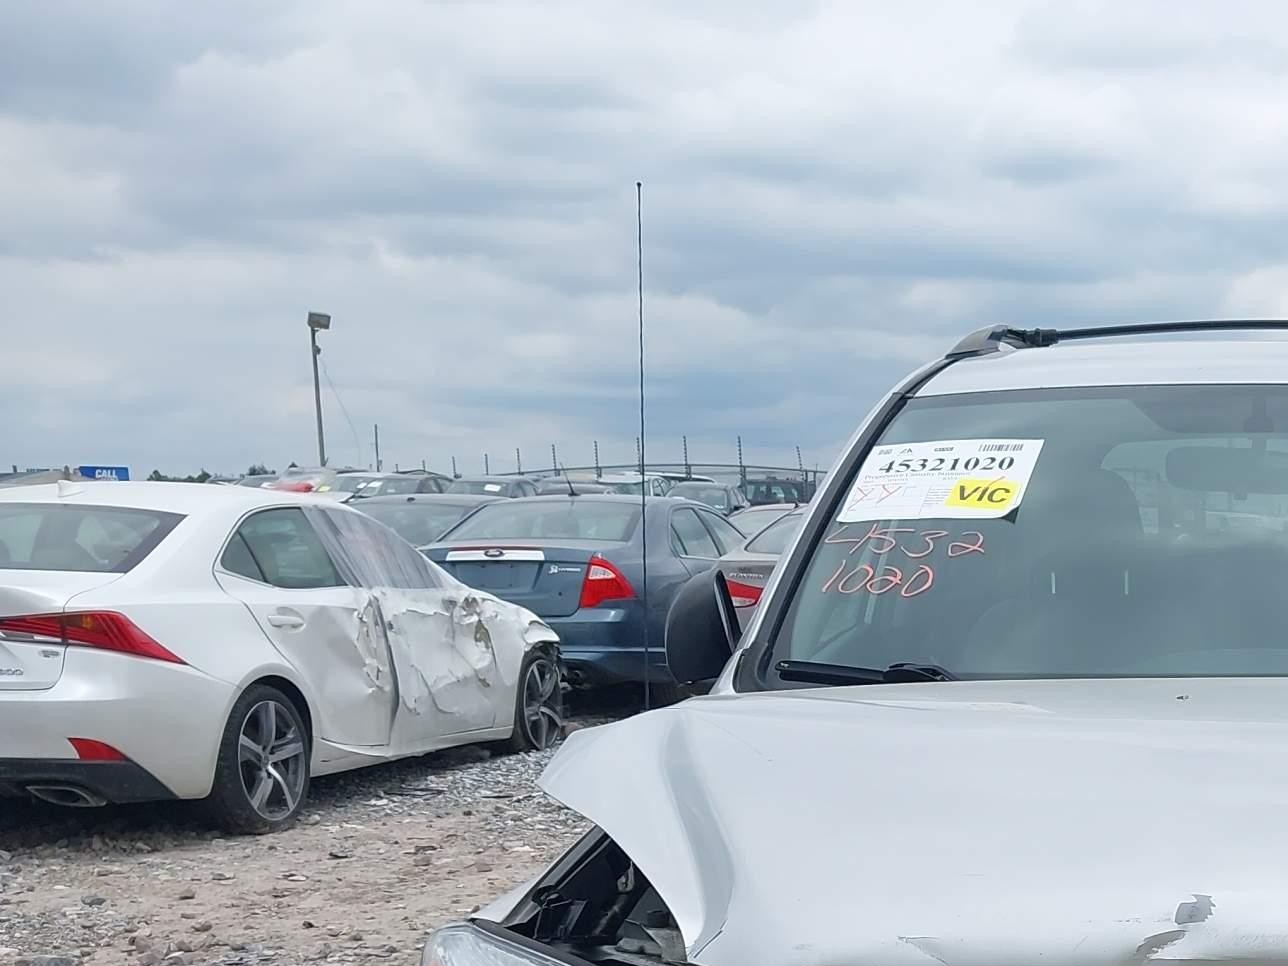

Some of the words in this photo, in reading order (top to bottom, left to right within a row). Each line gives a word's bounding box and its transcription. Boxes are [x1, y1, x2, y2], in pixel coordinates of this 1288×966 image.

[95, 469, 118, 479] CALL
[878, 456, 1015, 475] 45321020
[958, 485, 1011, 504] VIC
[824, 524, 985, 558] 4532
[822, 559, 935, 597] 1020
